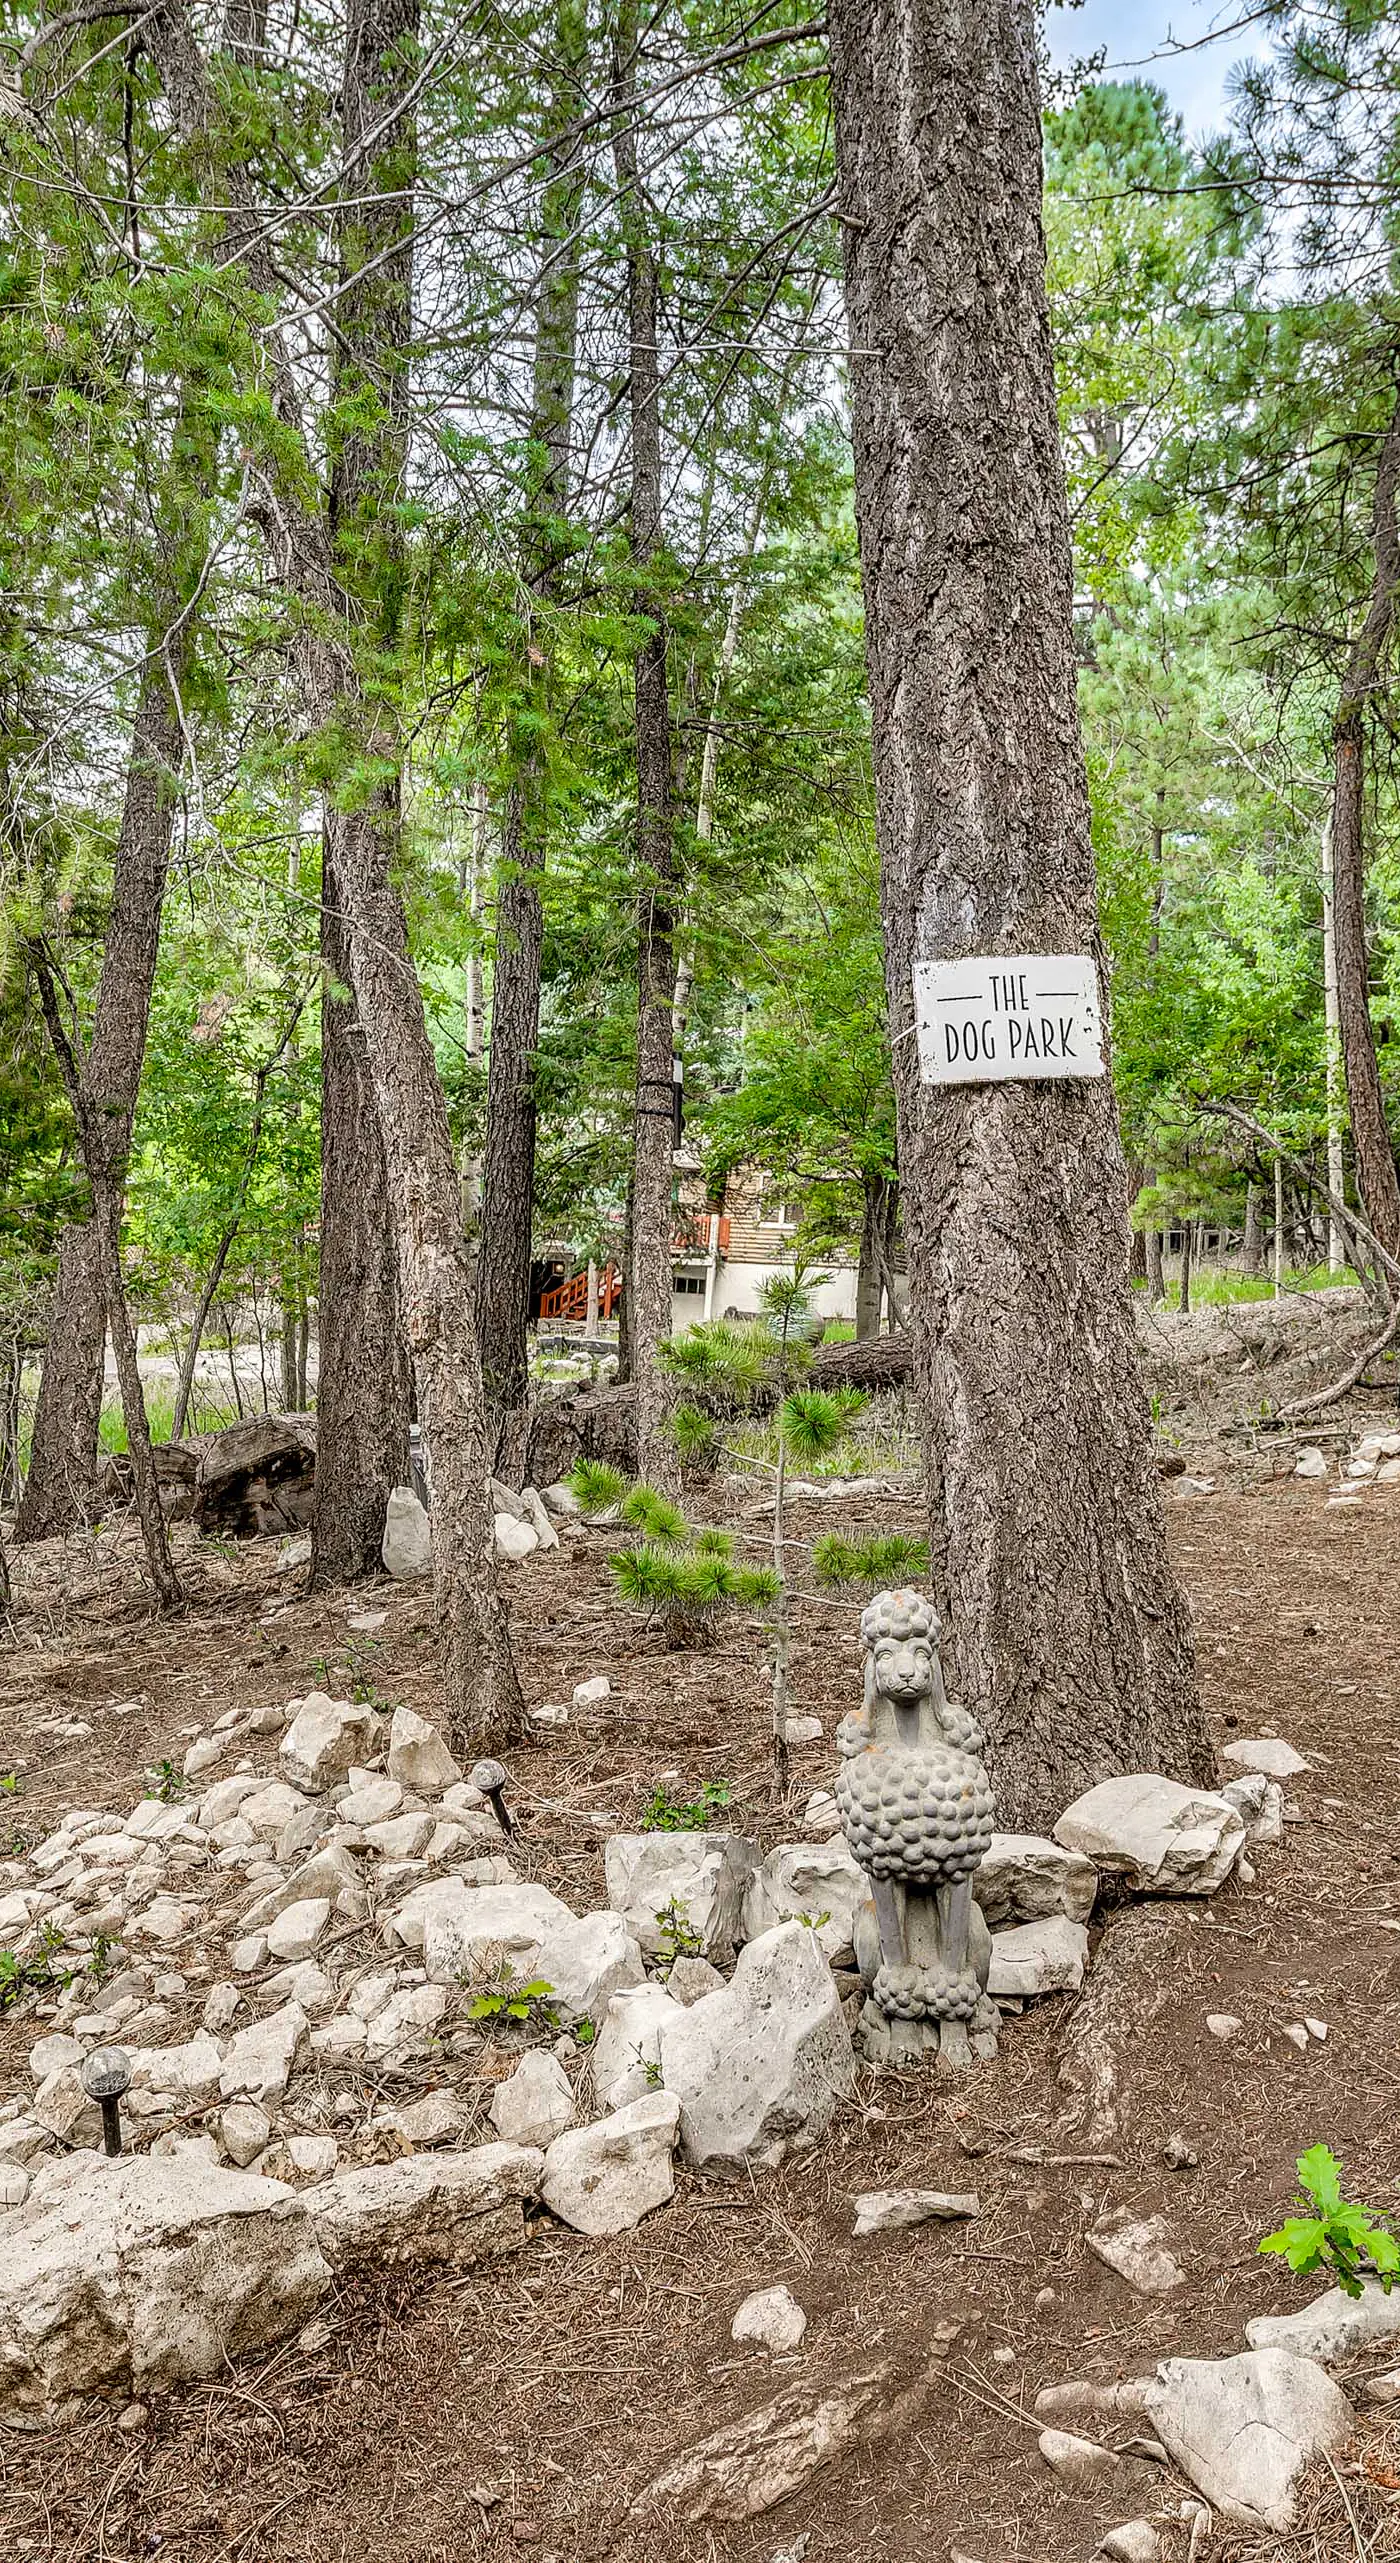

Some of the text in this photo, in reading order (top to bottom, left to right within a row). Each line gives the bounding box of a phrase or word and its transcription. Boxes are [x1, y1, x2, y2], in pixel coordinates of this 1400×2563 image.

[988, 974, 1030, 1012] THE
[944, 1017, 1078, 1064] DOG PARK
